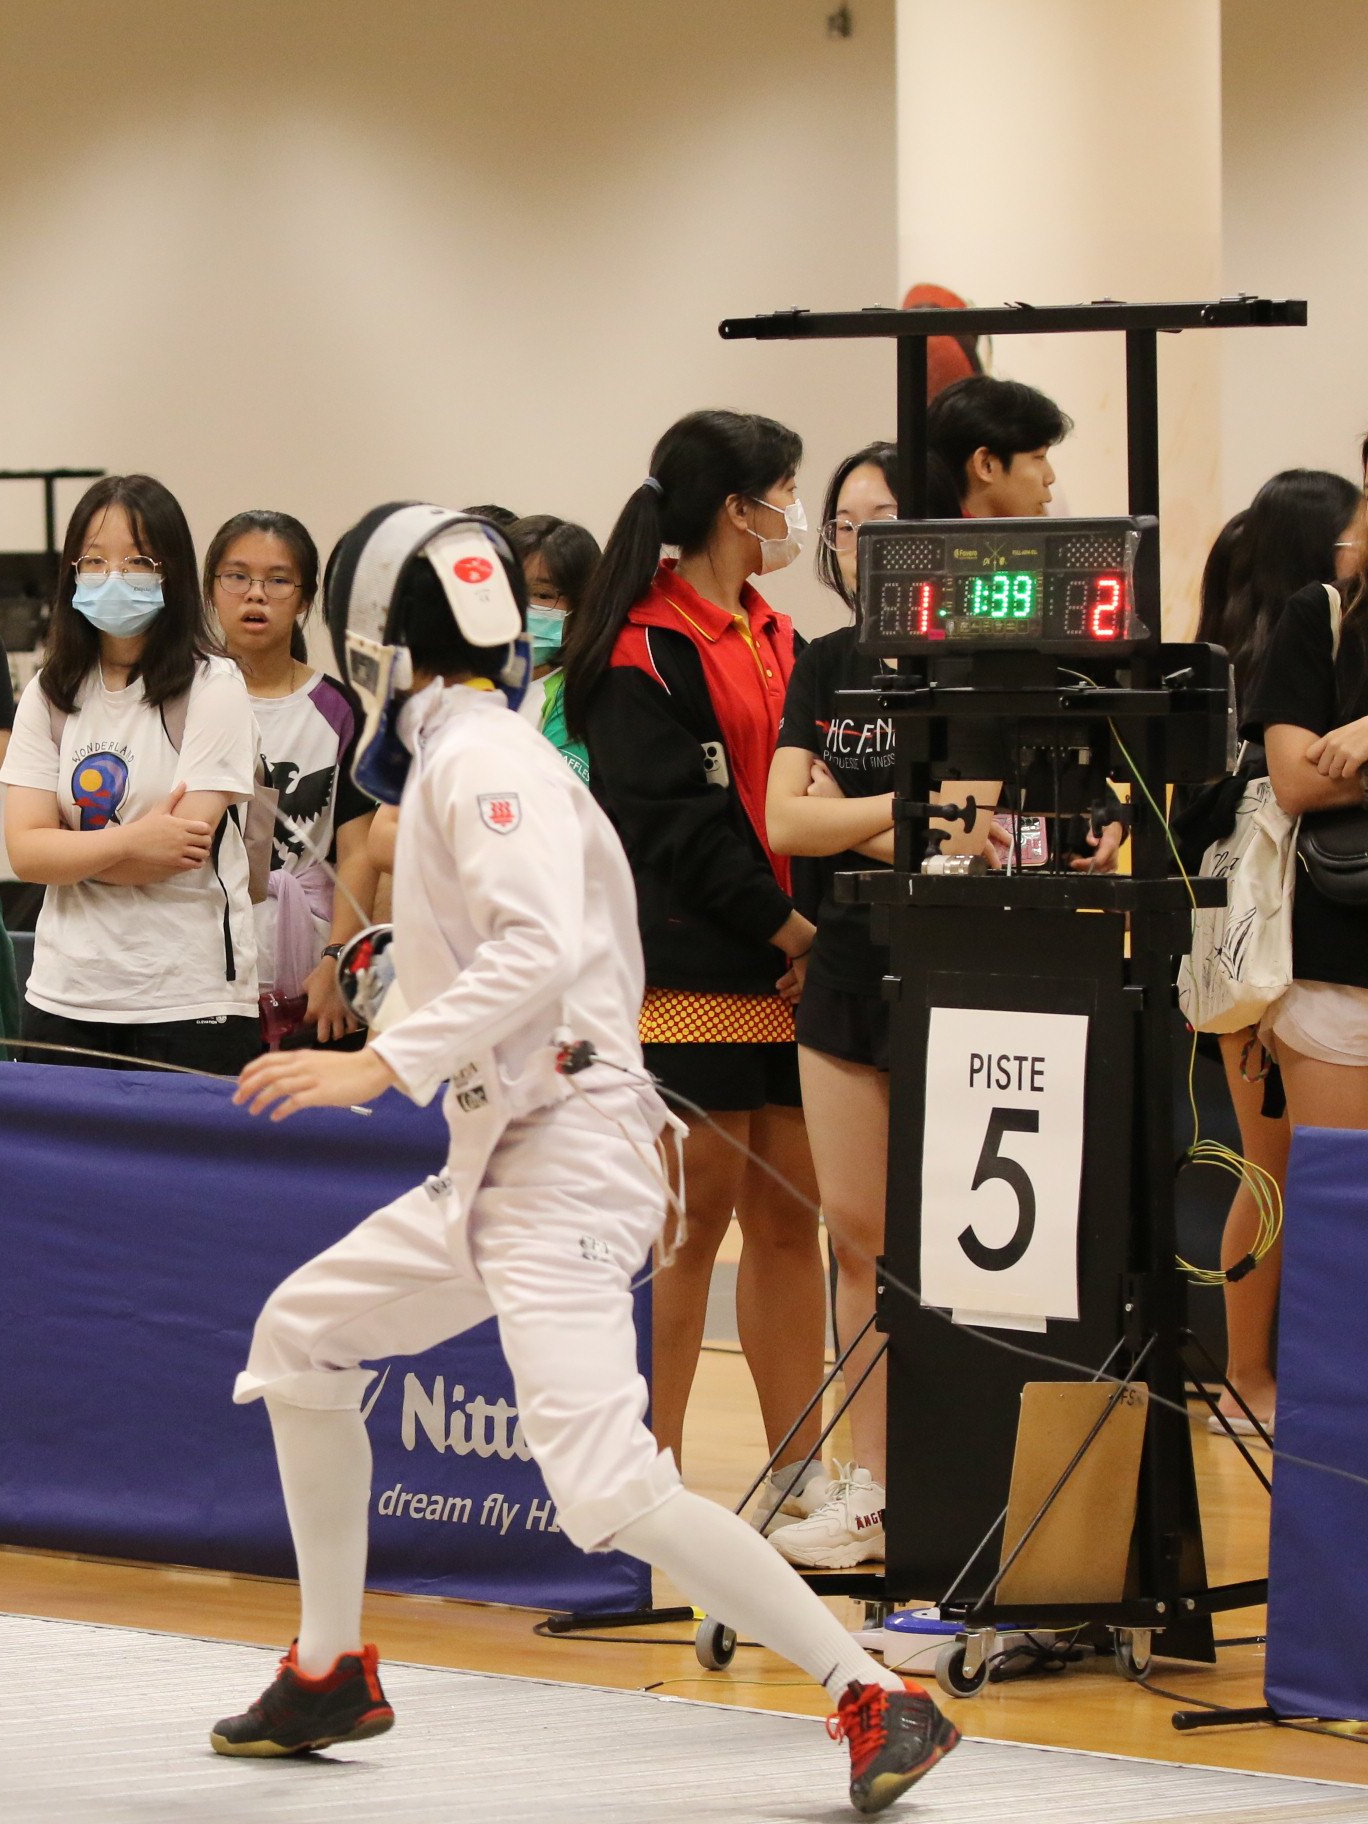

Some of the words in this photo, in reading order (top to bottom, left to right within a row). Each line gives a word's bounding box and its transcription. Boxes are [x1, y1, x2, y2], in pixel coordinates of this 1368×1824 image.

[920, 582, 931, 634] 1
[973, 575, 1033, 618] 1:39
[1093, 579, 1120, 635] 2
[969, 1053, 1045, 1092] PISTE
[957, 1107, 1039, 1272] 5
[378, 1483, 472, 1524] dream
[480, 1493, 521, 1536] fly
